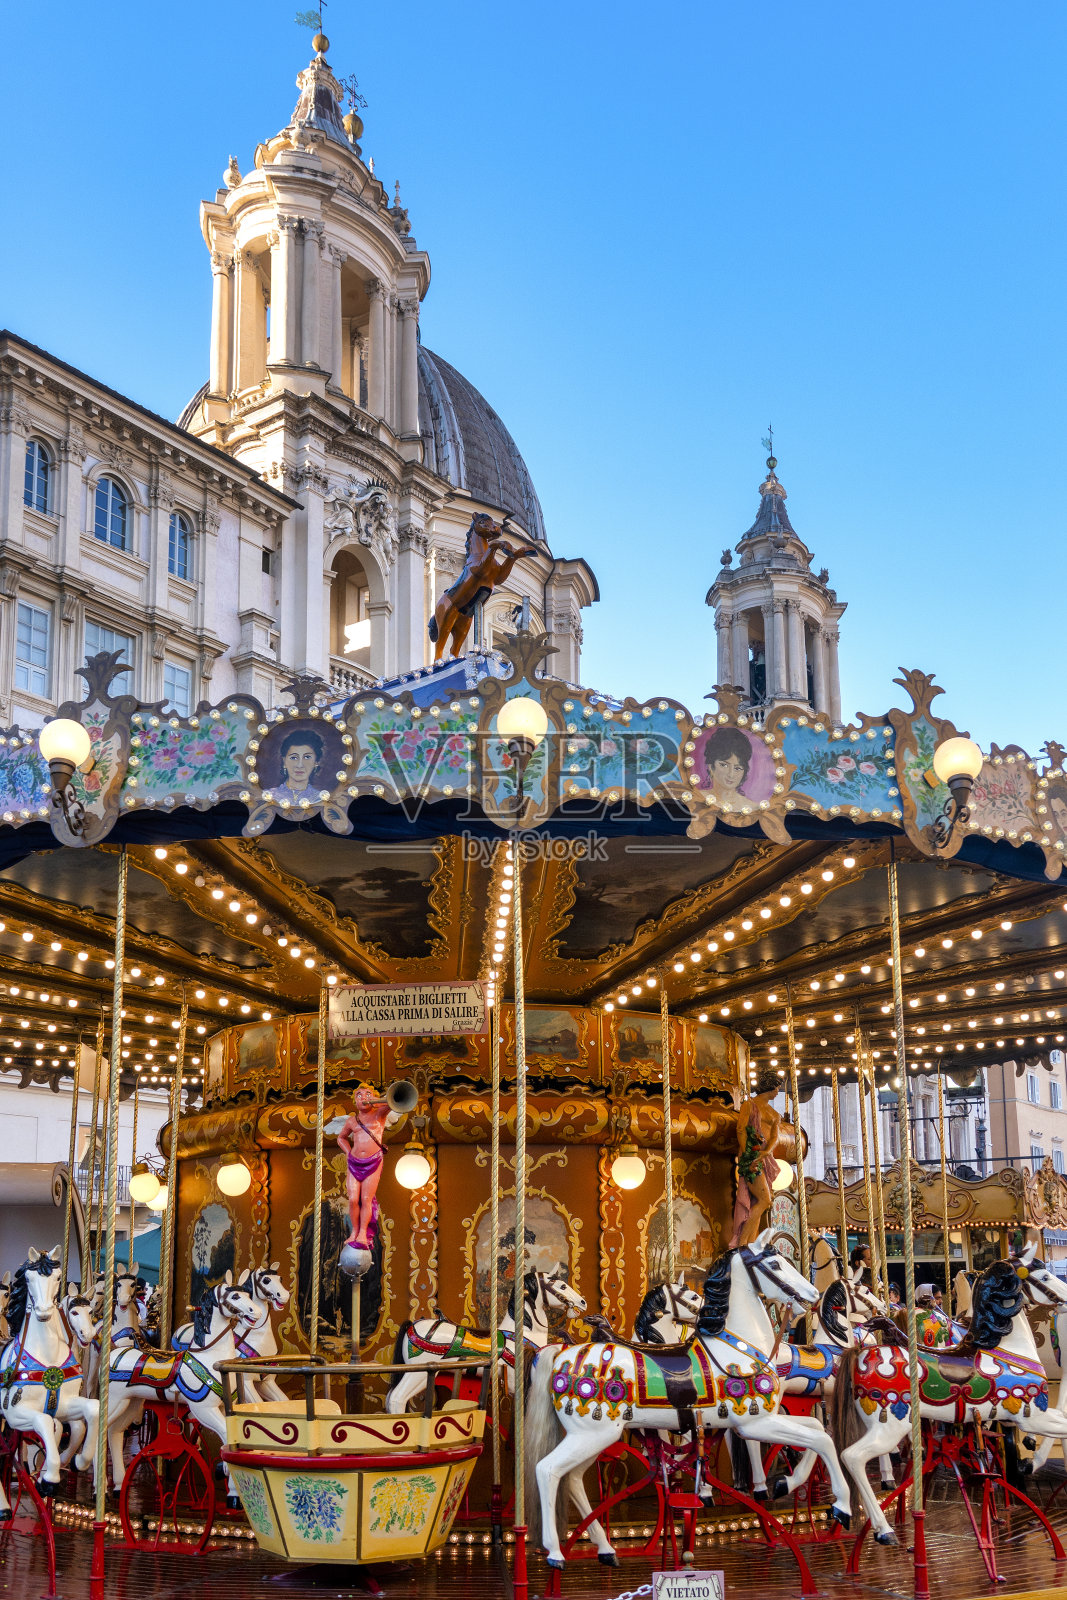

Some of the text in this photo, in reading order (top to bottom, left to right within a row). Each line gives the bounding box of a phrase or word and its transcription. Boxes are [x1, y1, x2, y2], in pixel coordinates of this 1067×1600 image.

[351, 992, 467, 1010] ACQUISTARE I BIGLIETTI
[340, 1006, 479, 1022] ALLA CASSA PRIMA DI SALIRE
[452, 1018, 473, 1026] Grazie
[666, 1587, 710, 1599] VIETATO
